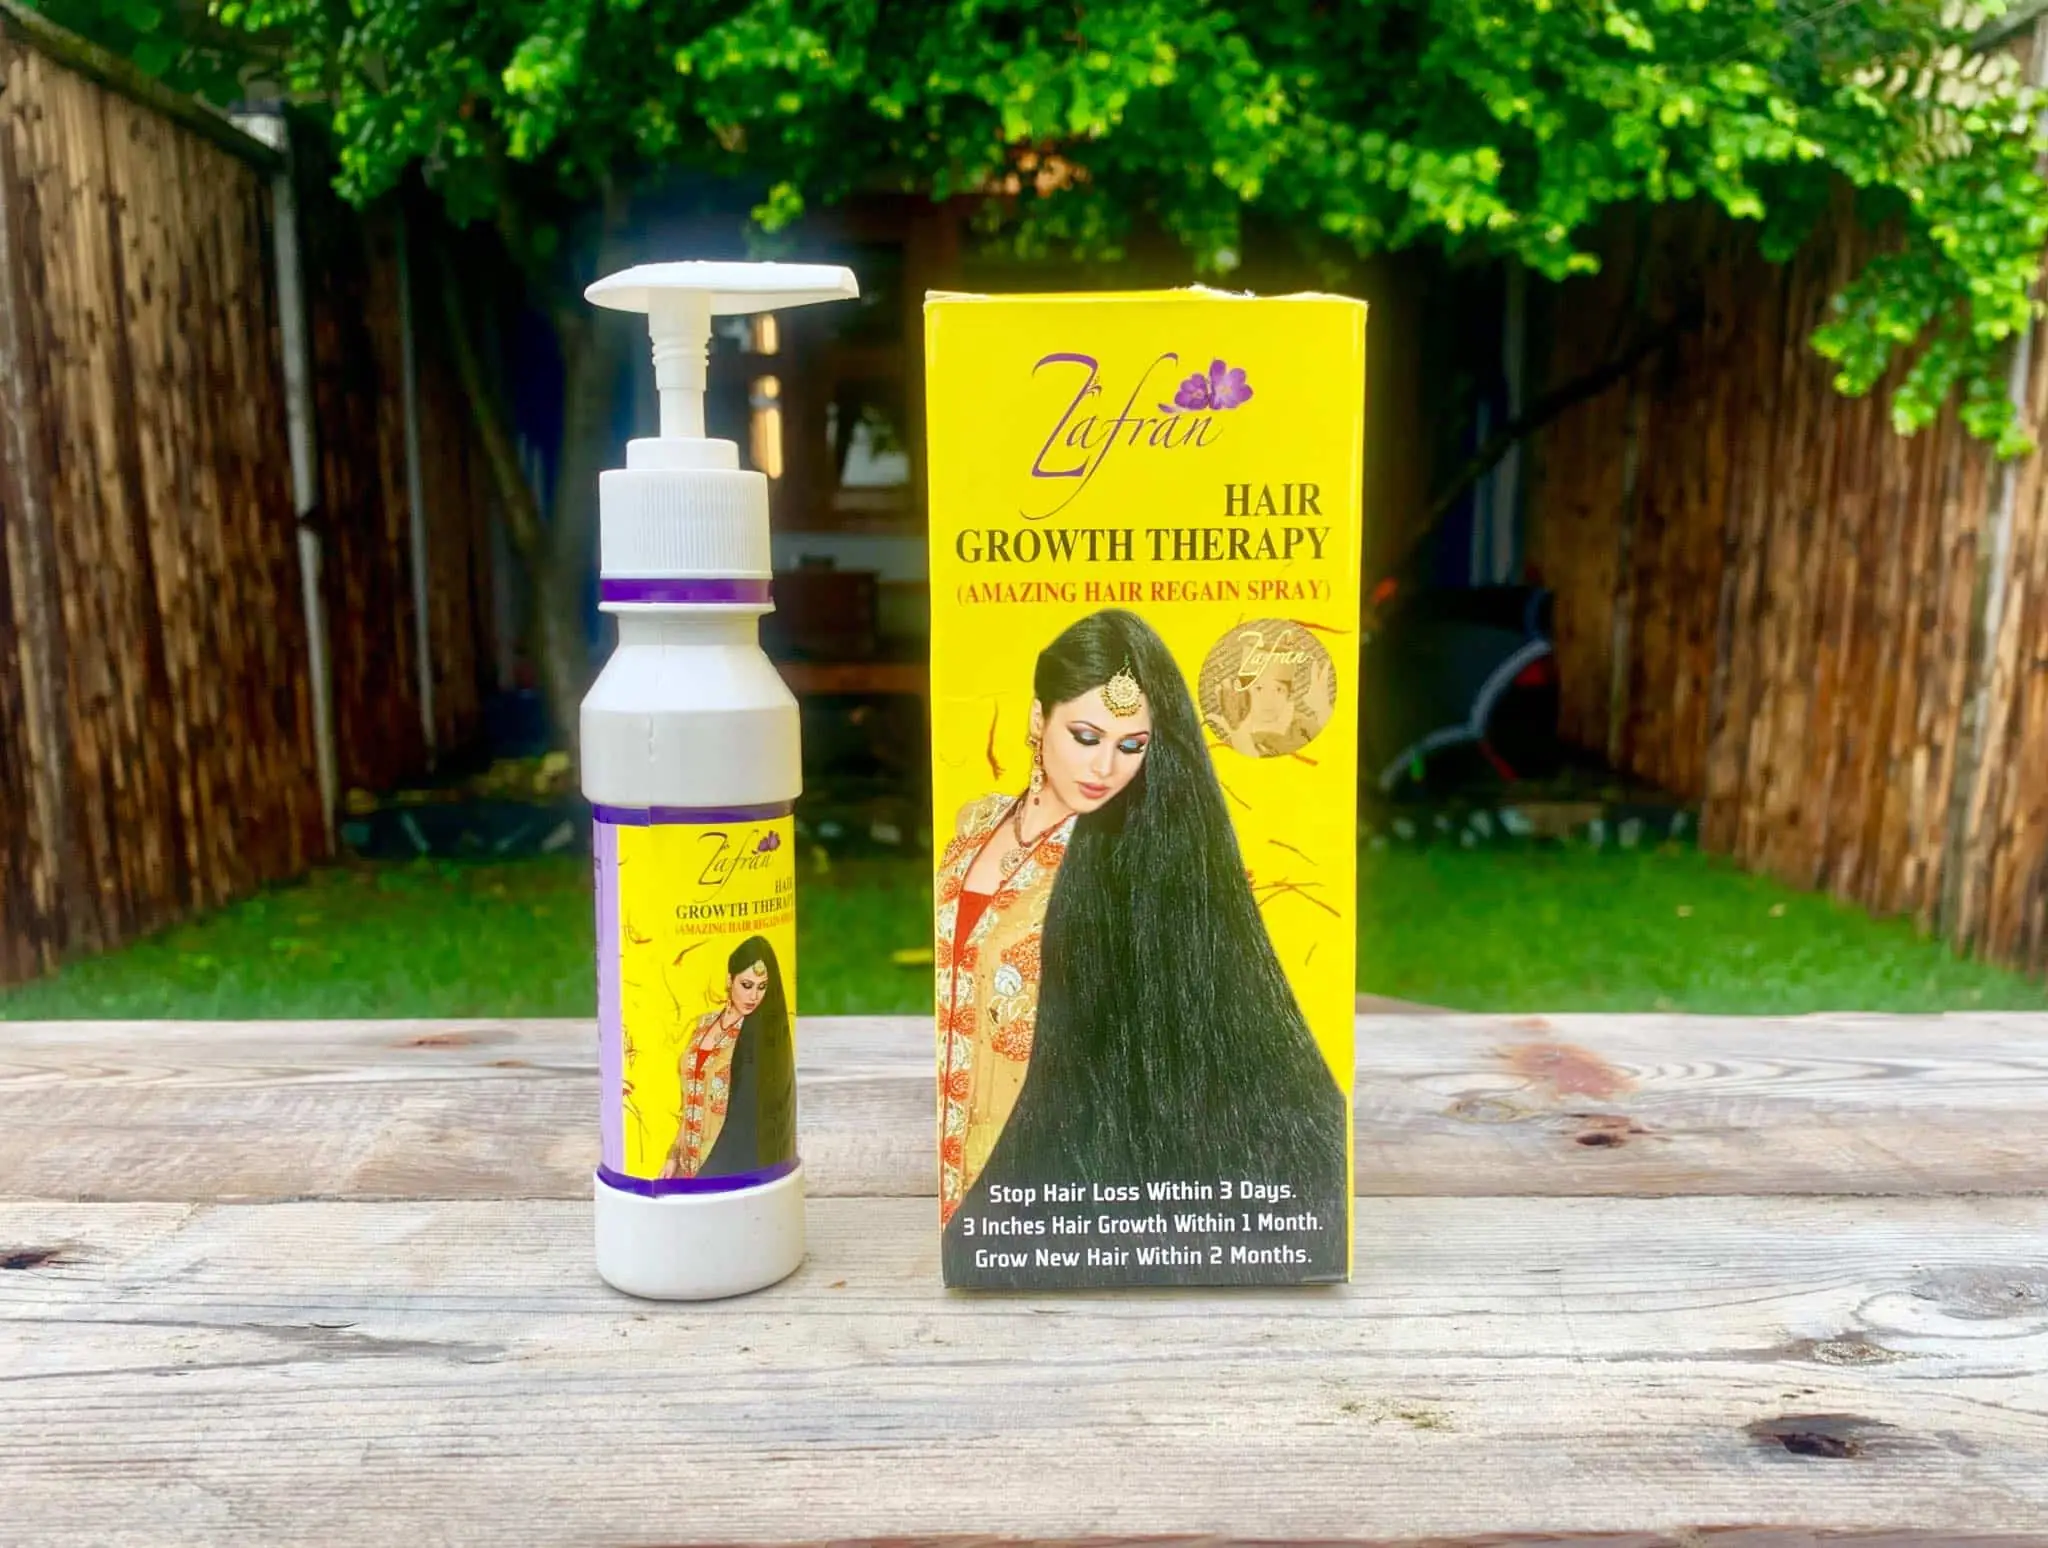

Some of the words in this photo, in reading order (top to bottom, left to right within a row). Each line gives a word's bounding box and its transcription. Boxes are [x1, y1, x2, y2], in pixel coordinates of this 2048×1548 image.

[1020, 352, 1224, 521] Zafran
[1224, 483, 1323, 517] HAIR
[956, 528, 1135, 564] GROWTH
[1146, 526, 1332, 562] THERAPY
[956, 581, 1078, 606] (AMAZING
[1084, 581, 1143, 604] HAIR
[1150, 580, 1241, 603] REGAIN
[1247, 578, 1332, 603] SPRAY)
[675, 902, 749, 920] GROWTH
[989, 1184, 1036, 1207] Stop
[1043, 1182, 1086, 1203] Hair
[1093, 1182, 1140, 1202] Loss
[1146, 1181, 1213, 1201] Within
[1219, 1181, 1232, 1200] 3
[1240, 1180, 1297, 1204] Days.
[963, 1217, 975, 1236] 3
[982, 1215, 1045, 1236] Inches
[1052, 1215, 1092, 1235] Hair
[1098, 1213, 1167, 1234] Growth
[1173, 1212, 1235, 1233] Within
[1241, 1213, 1251, 1232] 1
[1258, 1211, 1324, 1232] Month.
[975, 1249, 1028, 1268] Grow
[1035, 1248, 1080, 1267] New
[1087, 1247, 1129, 1266] Hair
[1136, 1246, 1202, 1266] Within
[1210, 1246, 1222, 1265] 2
[1230, 1244, 1313, 1264] Months.
